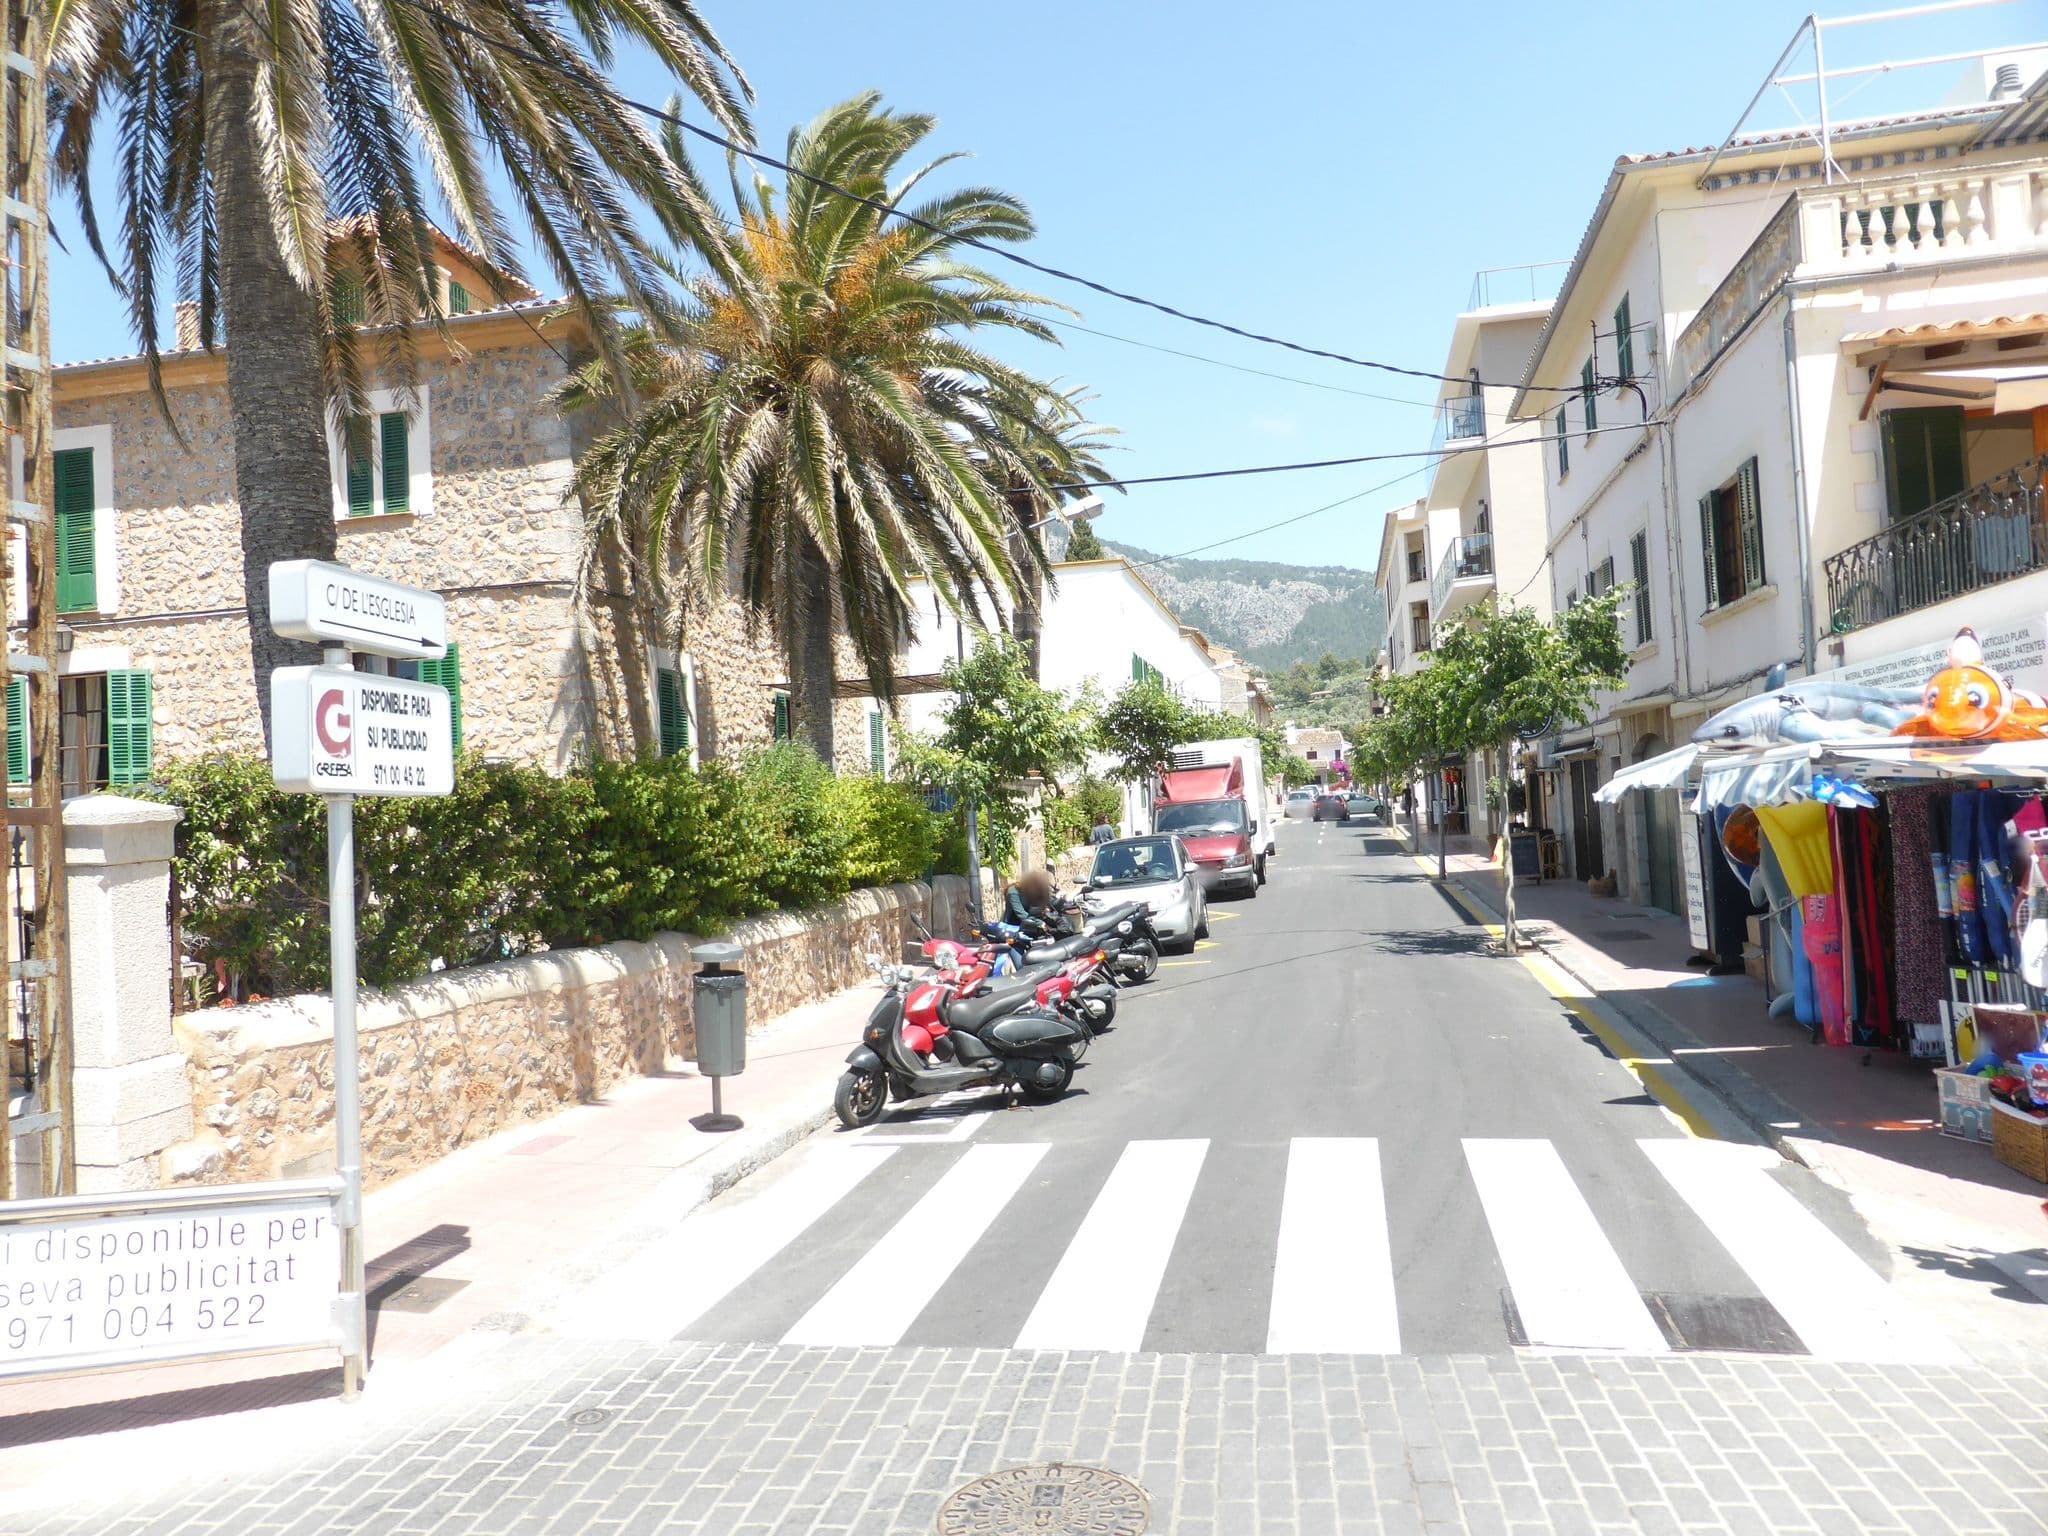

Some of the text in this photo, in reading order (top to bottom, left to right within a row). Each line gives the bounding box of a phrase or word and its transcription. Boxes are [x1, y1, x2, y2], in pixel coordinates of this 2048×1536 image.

[326, 583, 416, 625] C/ DE L'ESGLESIA
[2010, 628, 2030, 642] PLAYA
[2014, 639, 2046, 654] PATENTES
[361, 688, 431, 718] DISPONIBLE PARA
[367, 726, 428, 751] SU PUBLICIDAD
[316, 762, 352, 777] GREPSA
[373, 764, 426, 786] 971 00 45 22
[35, 1216, 246, 1264] disponible
[267, 1214, 326, 1249] per
[107, 1253, 296, 1305] publicitat
[8, 1294, 266, 1350] 971 004 522
